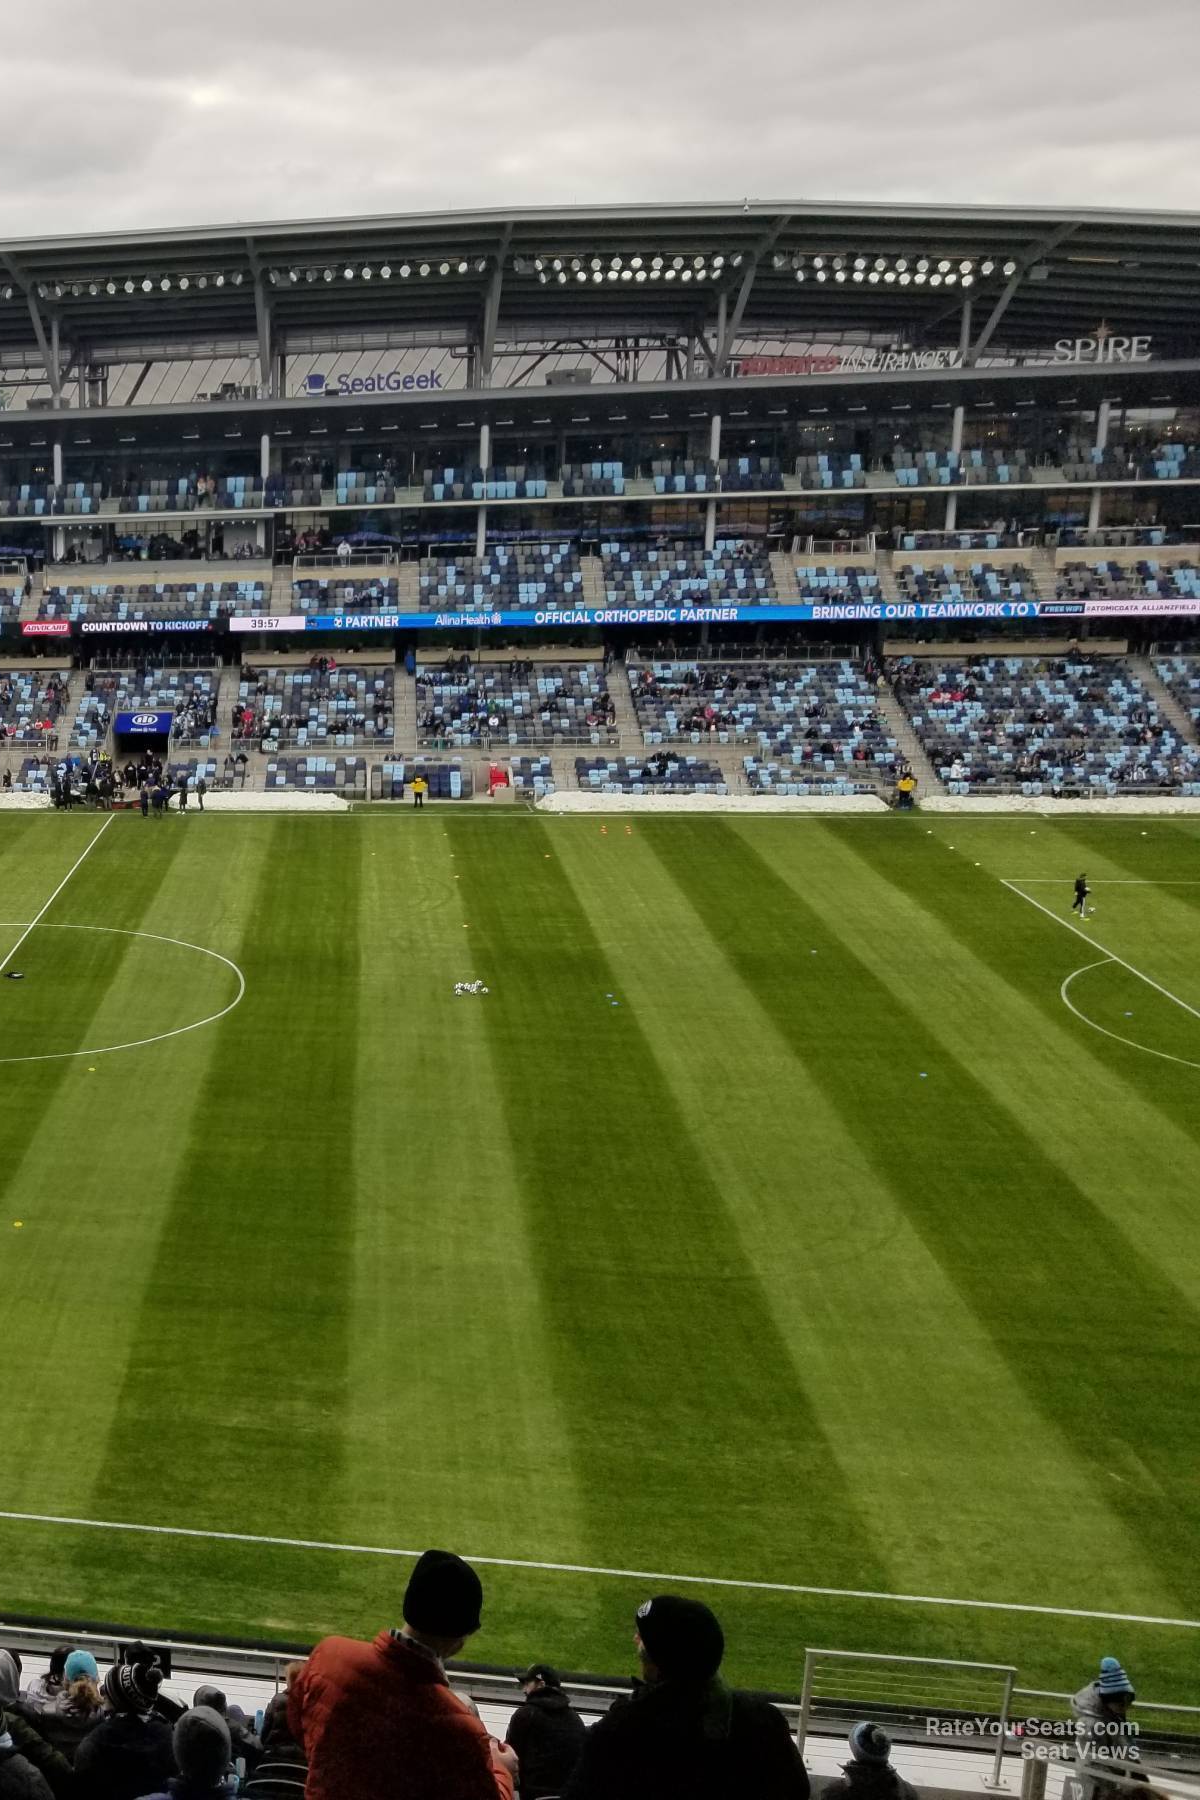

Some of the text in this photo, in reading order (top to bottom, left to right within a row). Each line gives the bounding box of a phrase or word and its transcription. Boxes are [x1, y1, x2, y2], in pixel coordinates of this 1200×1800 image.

[1054, 336, 1152, 363] SPIRE
[839, 351, 946, 372] INSURANCE
[337, 369, 443, 395] SeatGeek
[534, 608, 738, 624] OFFICIAL ORTHOPEDIC PARTNER
[812, 605, 881, 619] BRINGING
[885, 604, 916, 618] OUR
[919, 603, 1005, 618] TEAMWORK
[1008, 603, 1029, 616] TO
[81, 622, 148, 632] COUNTDOWN
[149, 622, 163, 631] TO
[250, 619, 280, 629] 39:57
[345, 615, 399, 628] PARTNER
